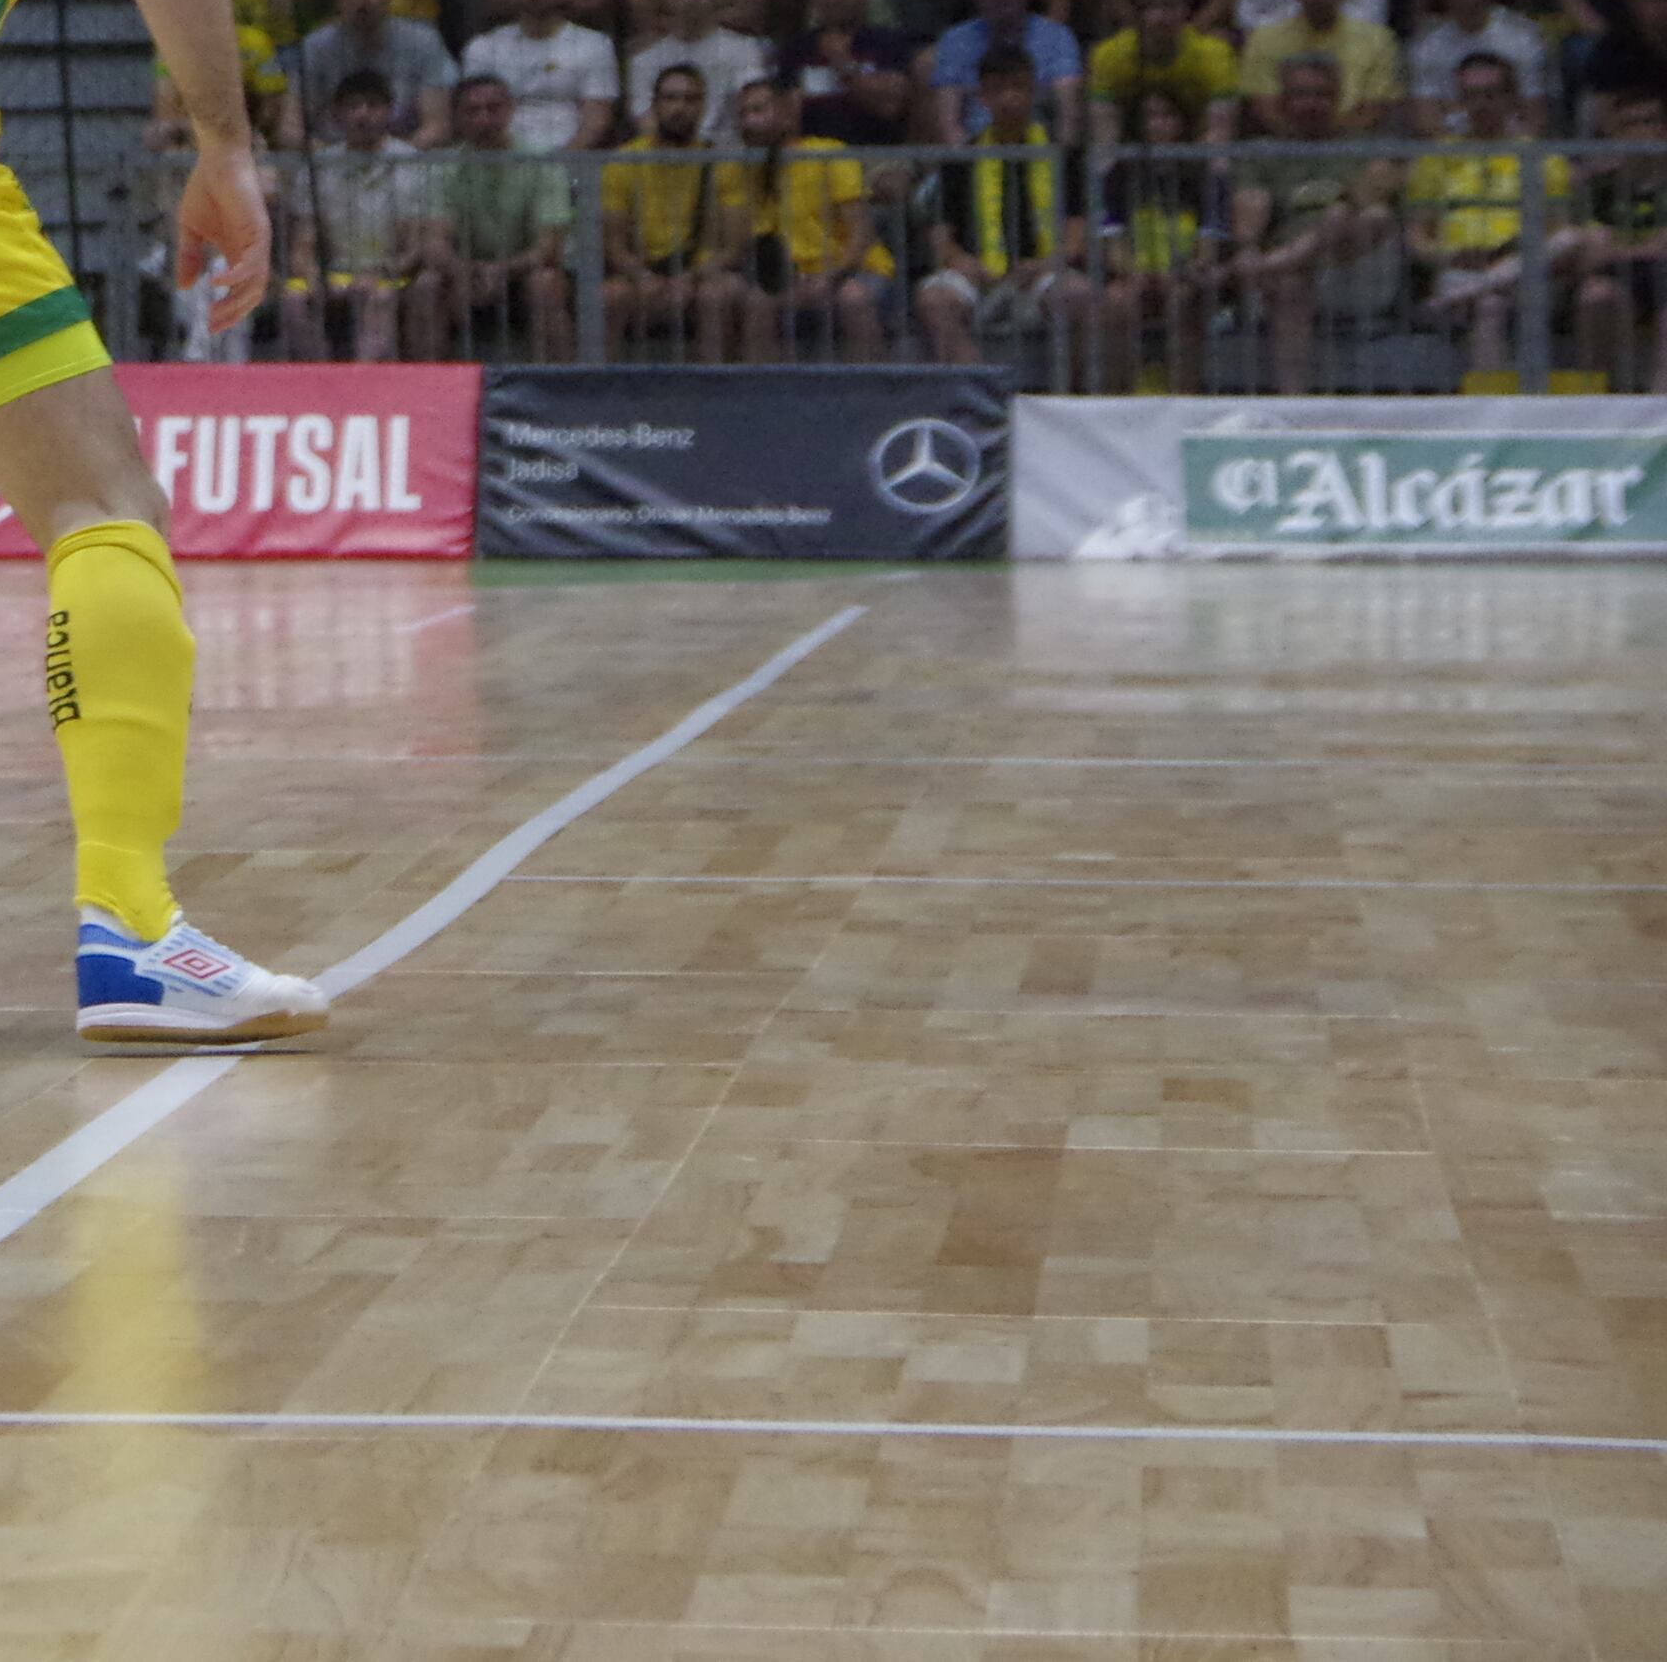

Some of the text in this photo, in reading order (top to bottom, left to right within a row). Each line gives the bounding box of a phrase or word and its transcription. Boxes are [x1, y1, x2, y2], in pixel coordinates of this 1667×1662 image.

[153, 414, 423, 512] FUTSAL
[508, 458, 579, 483] Jadisa
[1275, 449, 1643, 535] Alcázar
[45, 609, 81, 733] Blanca
